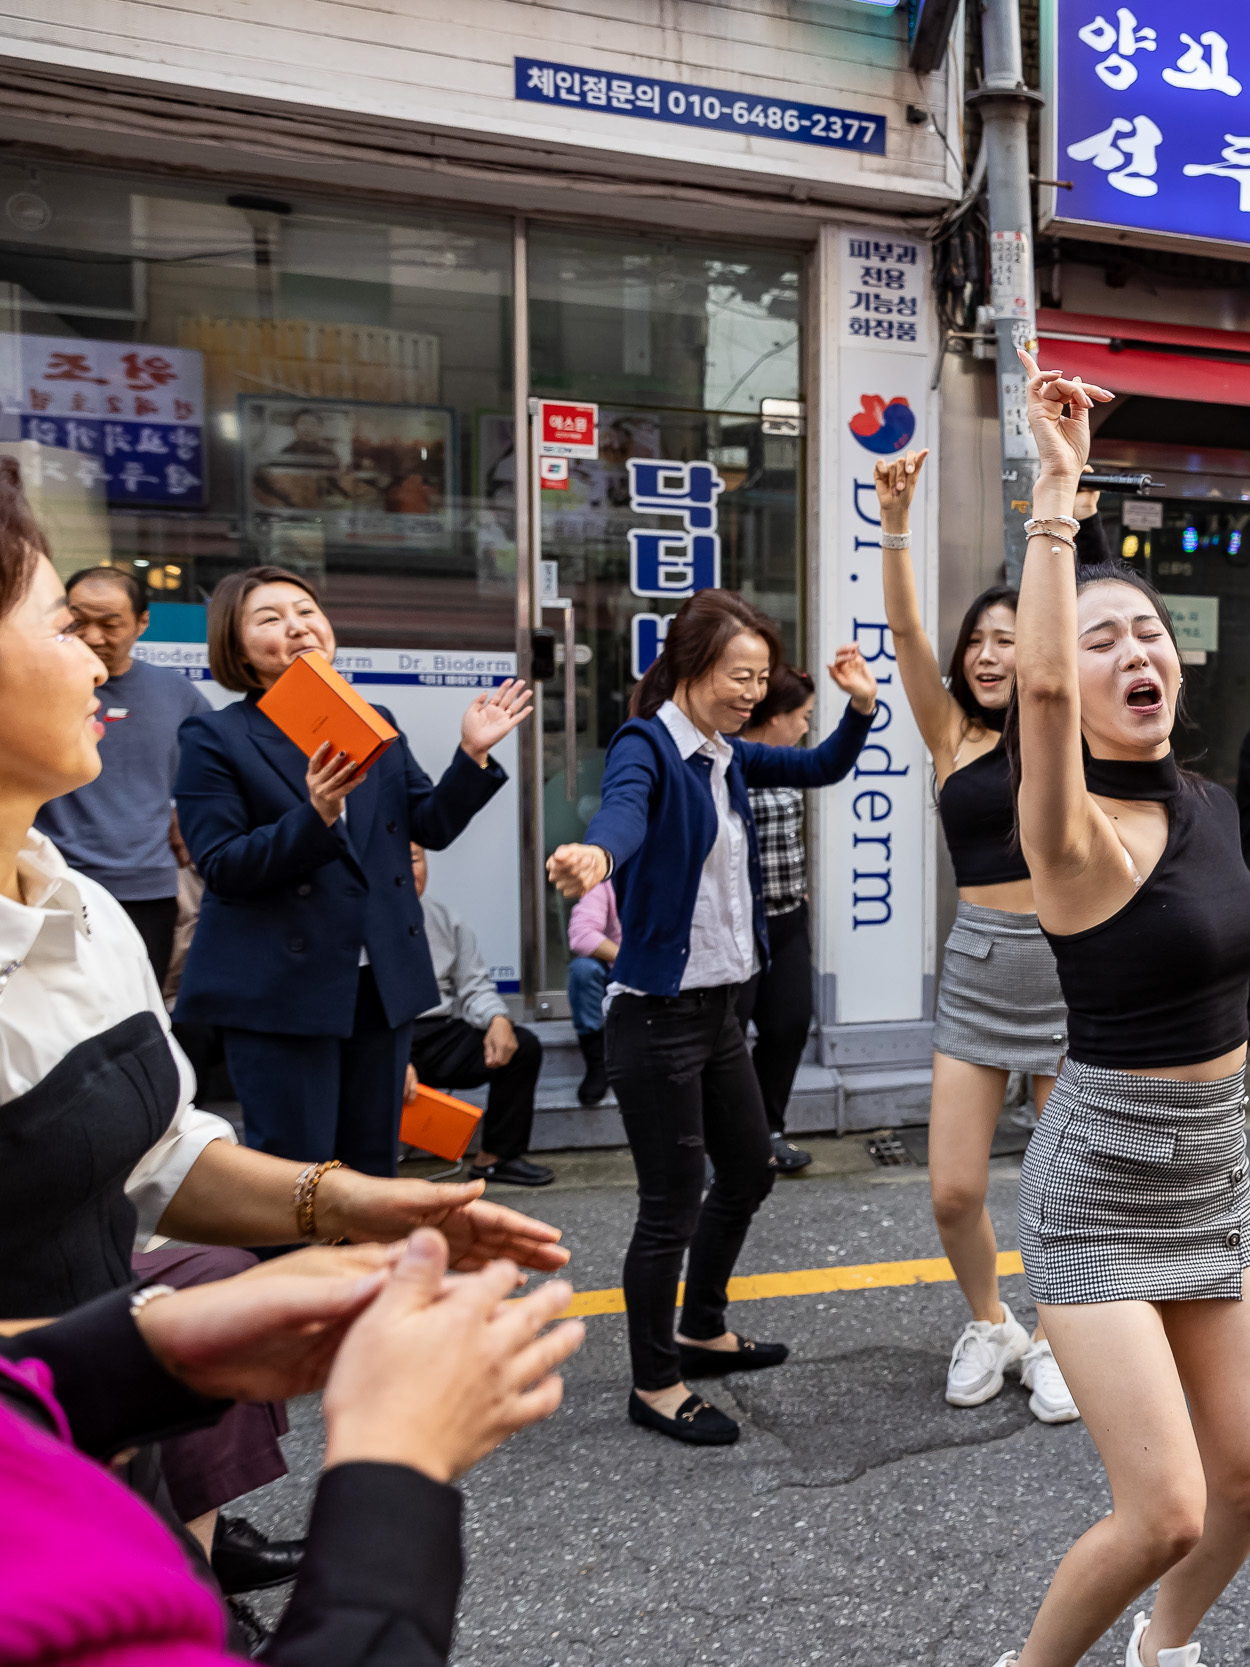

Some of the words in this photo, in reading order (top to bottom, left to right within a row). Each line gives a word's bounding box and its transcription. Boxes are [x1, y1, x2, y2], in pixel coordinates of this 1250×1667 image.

[526, 65, 662, 115] 체인점문의
[667, 90, 878, 145] 010-6486-2377
[848, 239, 918, 266] 피부과
[860, 265, 906, 290] 전용
[848, 290, 918, 317] 기능성
[848, 317, 918, 343] 화장품
[135, 646, 208, 663] Bioder
[398, 654, 428, 671] Dr.
[433, 655, 512, 672] Bioderm
